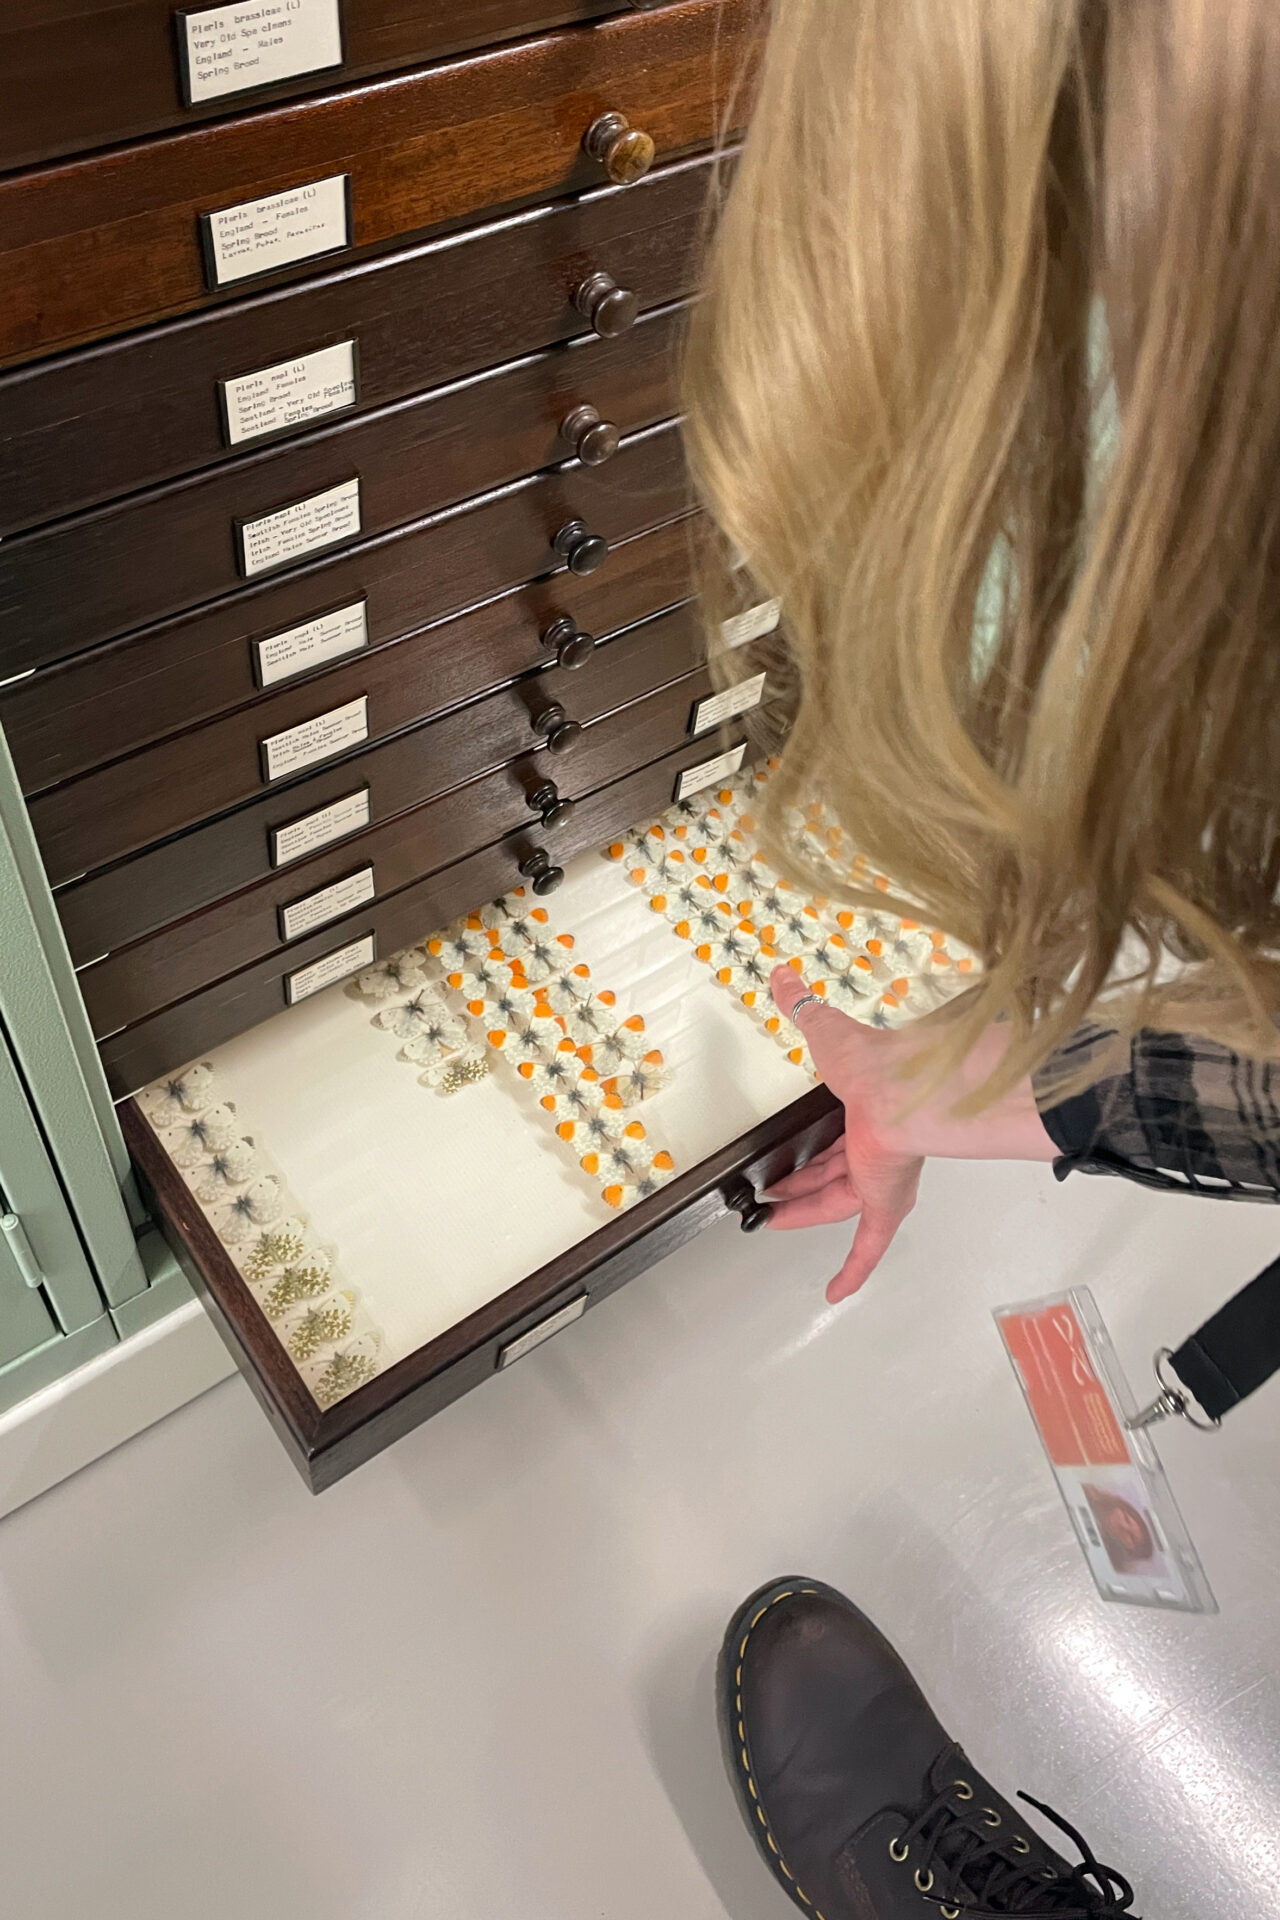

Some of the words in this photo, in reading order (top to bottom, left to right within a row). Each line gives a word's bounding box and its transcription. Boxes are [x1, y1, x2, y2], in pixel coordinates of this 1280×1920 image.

[192, 21, 224, 34] Pieris
[235, 7, 282, 23] brassicae
[286, 0, 301, 12] (L)
[194, 39, 216, 50] Very
[220, 34, 236, 43] Old
[196, 49, 233, 65] England
[198, 66, 230, 81] Spring
[234, 57, 260, 70] Brood
[219, 212, 248, 224] Pieris
[256, 196, 299, 213] brassicae
[303, 188, 316, 199] (L)
[220, 222, 254, 238] England
[276, 206, 309, 220] Females
[222, 237, 251, 251] Spring
[255, 228, 278, 239] Brood
[236, 380, 263, 393] Pieris
[272, 370, 288, 381] napi
[293, 364, 305, 374] (L)
[238, 388, 269, 403] England
[276, 376, 306, 389] Females
[239, 400, 266, 414] Spring
[270, 392, 291, 402] Brood
[240, 407, 275, 424] Scotland
[287, 398, 304, 407] Very
[241, 418, 276, 434] Scotland
[246, 519, 271, 531] Pieris
[281, 527, 297, 536] Very
